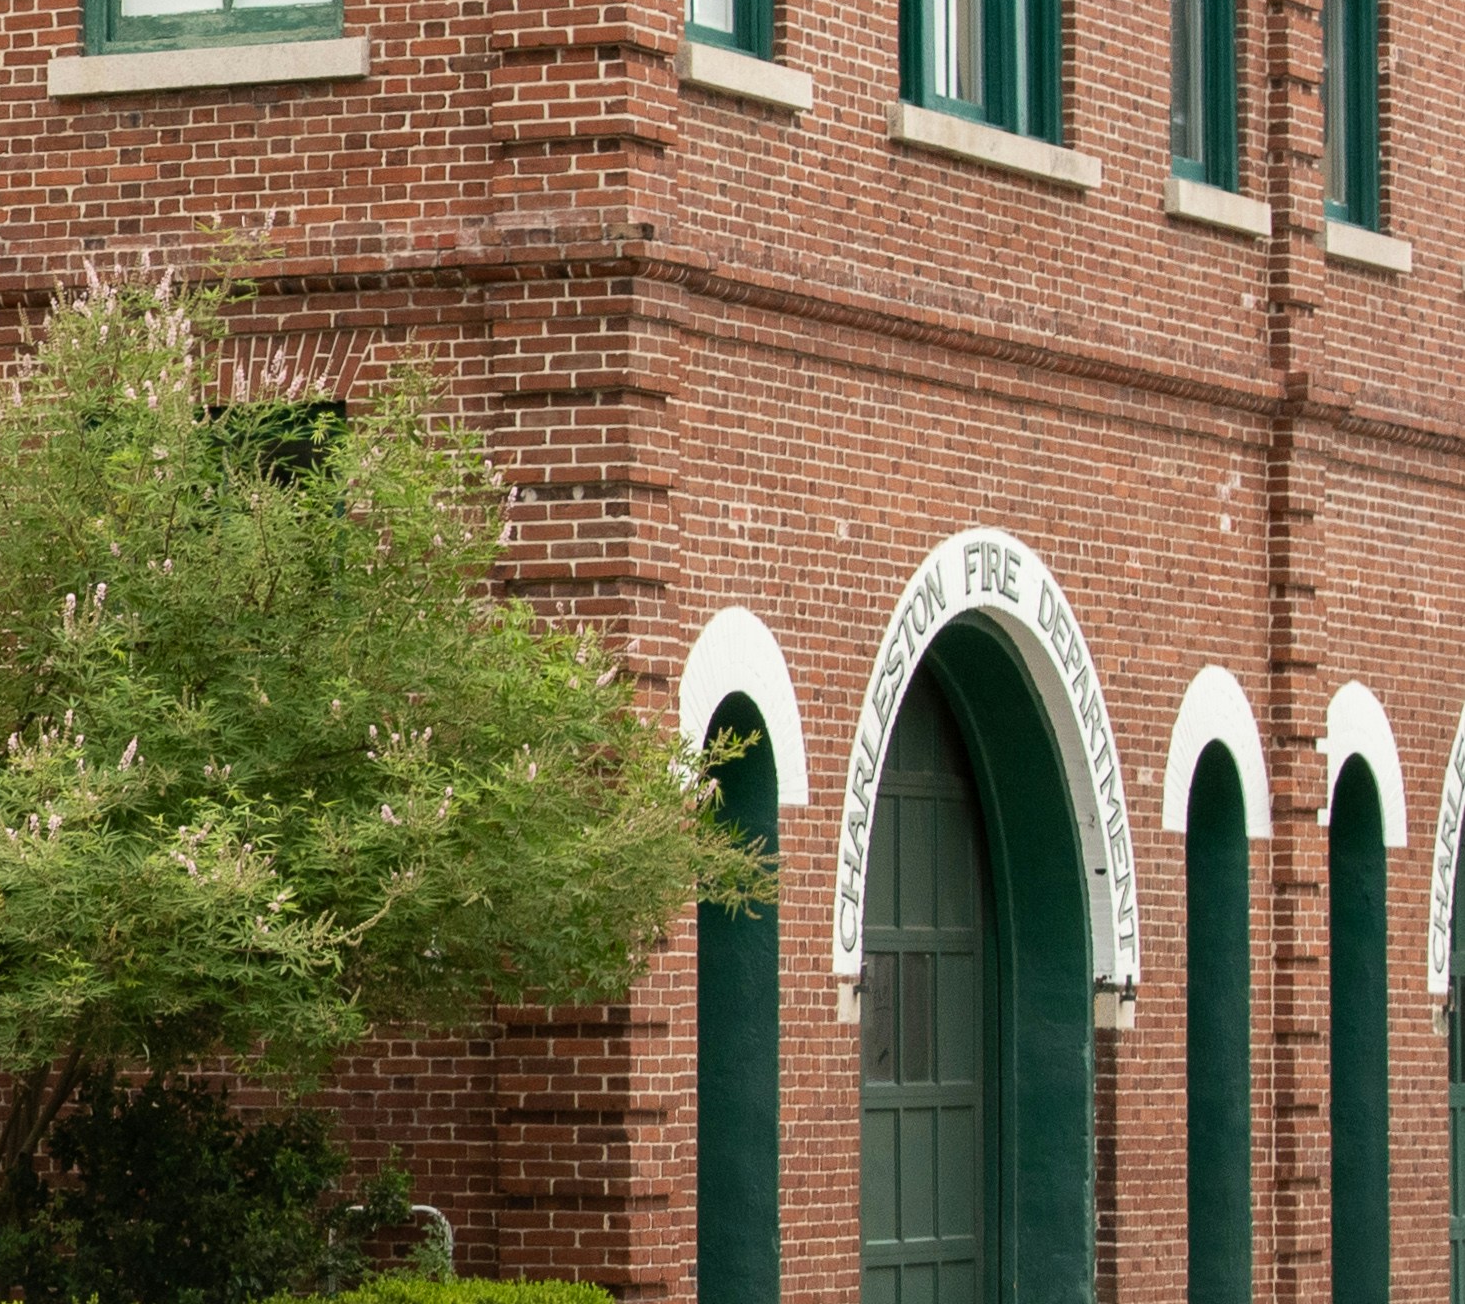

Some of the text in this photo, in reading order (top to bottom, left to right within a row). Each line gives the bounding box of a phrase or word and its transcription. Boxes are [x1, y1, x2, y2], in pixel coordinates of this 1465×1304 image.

[840, 541, 1138, 966] CHARLESTON FIRE DEPARTMENT
